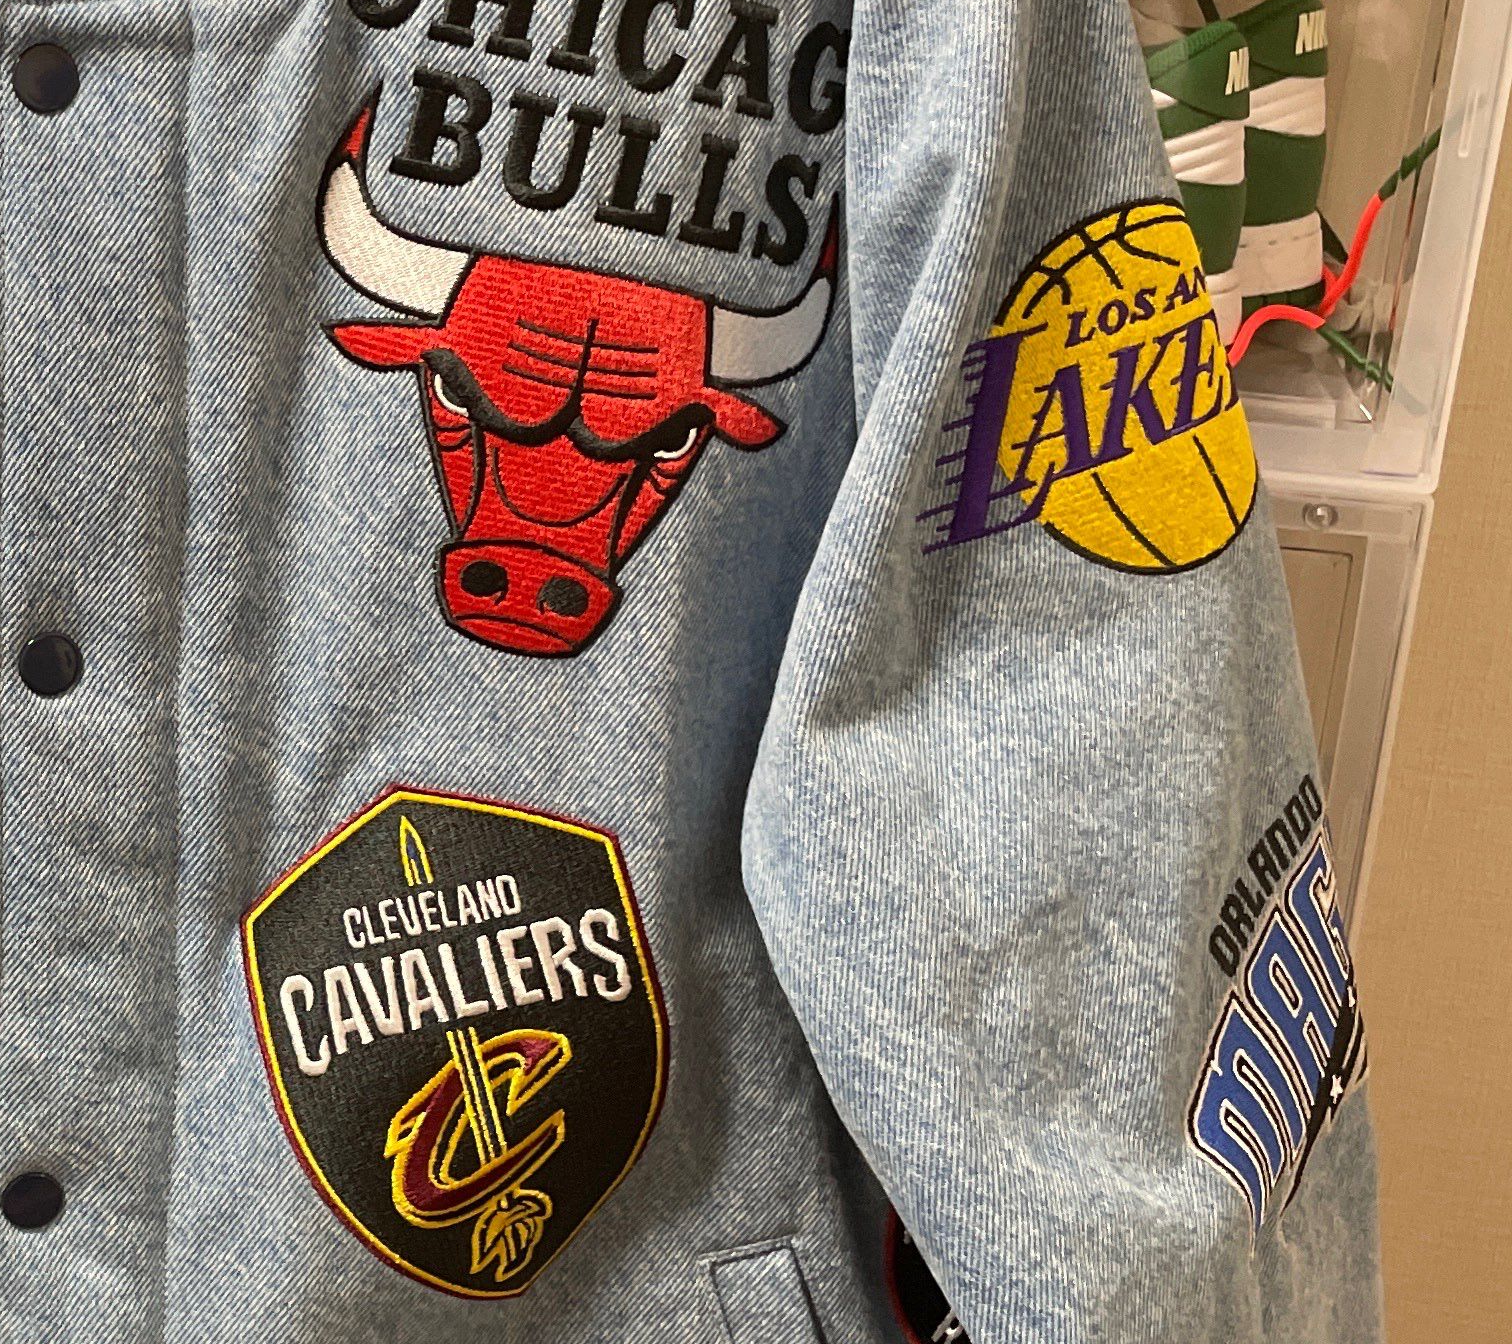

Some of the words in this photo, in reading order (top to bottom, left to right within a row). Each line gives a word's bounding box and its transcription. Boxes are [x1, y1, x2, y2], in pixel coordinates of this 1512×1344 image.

[1224, 46, 1250, 96] NI
[389, 65, 821, 268] BULLS
[1064, 288, 1158, 348] LOS
[916, 308, 1240, 555] LAKE
[342, 874, 523, 950] CLEVELAND
[1208, 773, 1325, 979] ORLANDO
[279, 908, 633, 1077] CAVALIERS
